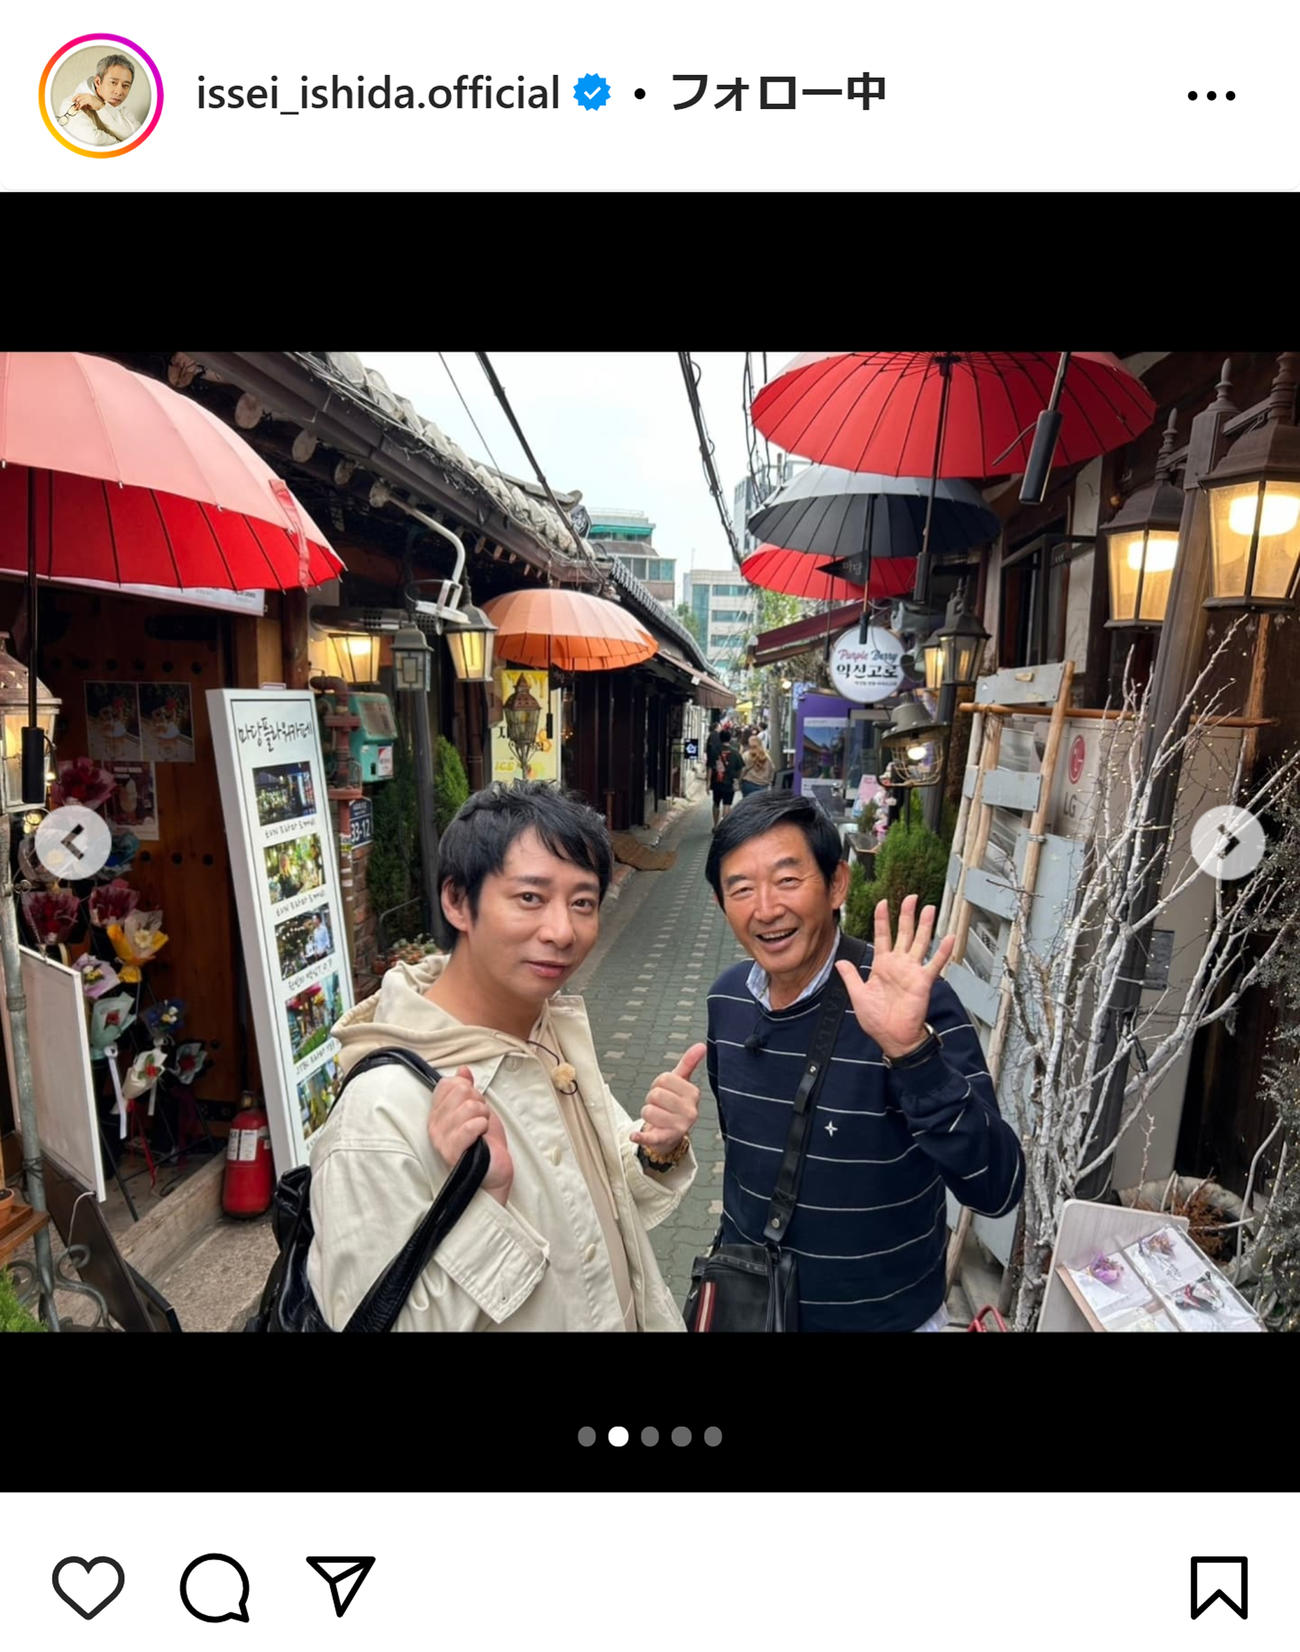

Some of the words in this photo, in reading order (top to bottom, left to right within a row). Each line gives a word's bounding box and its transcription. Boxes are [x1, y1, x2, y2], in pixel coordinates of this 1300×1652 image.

[837, 649, 868, 662] Purple
[870, 649, 899, 664] Berry
[1063, 792, 1078, 818] LG
[350, 818, 371, 843] 33-12
